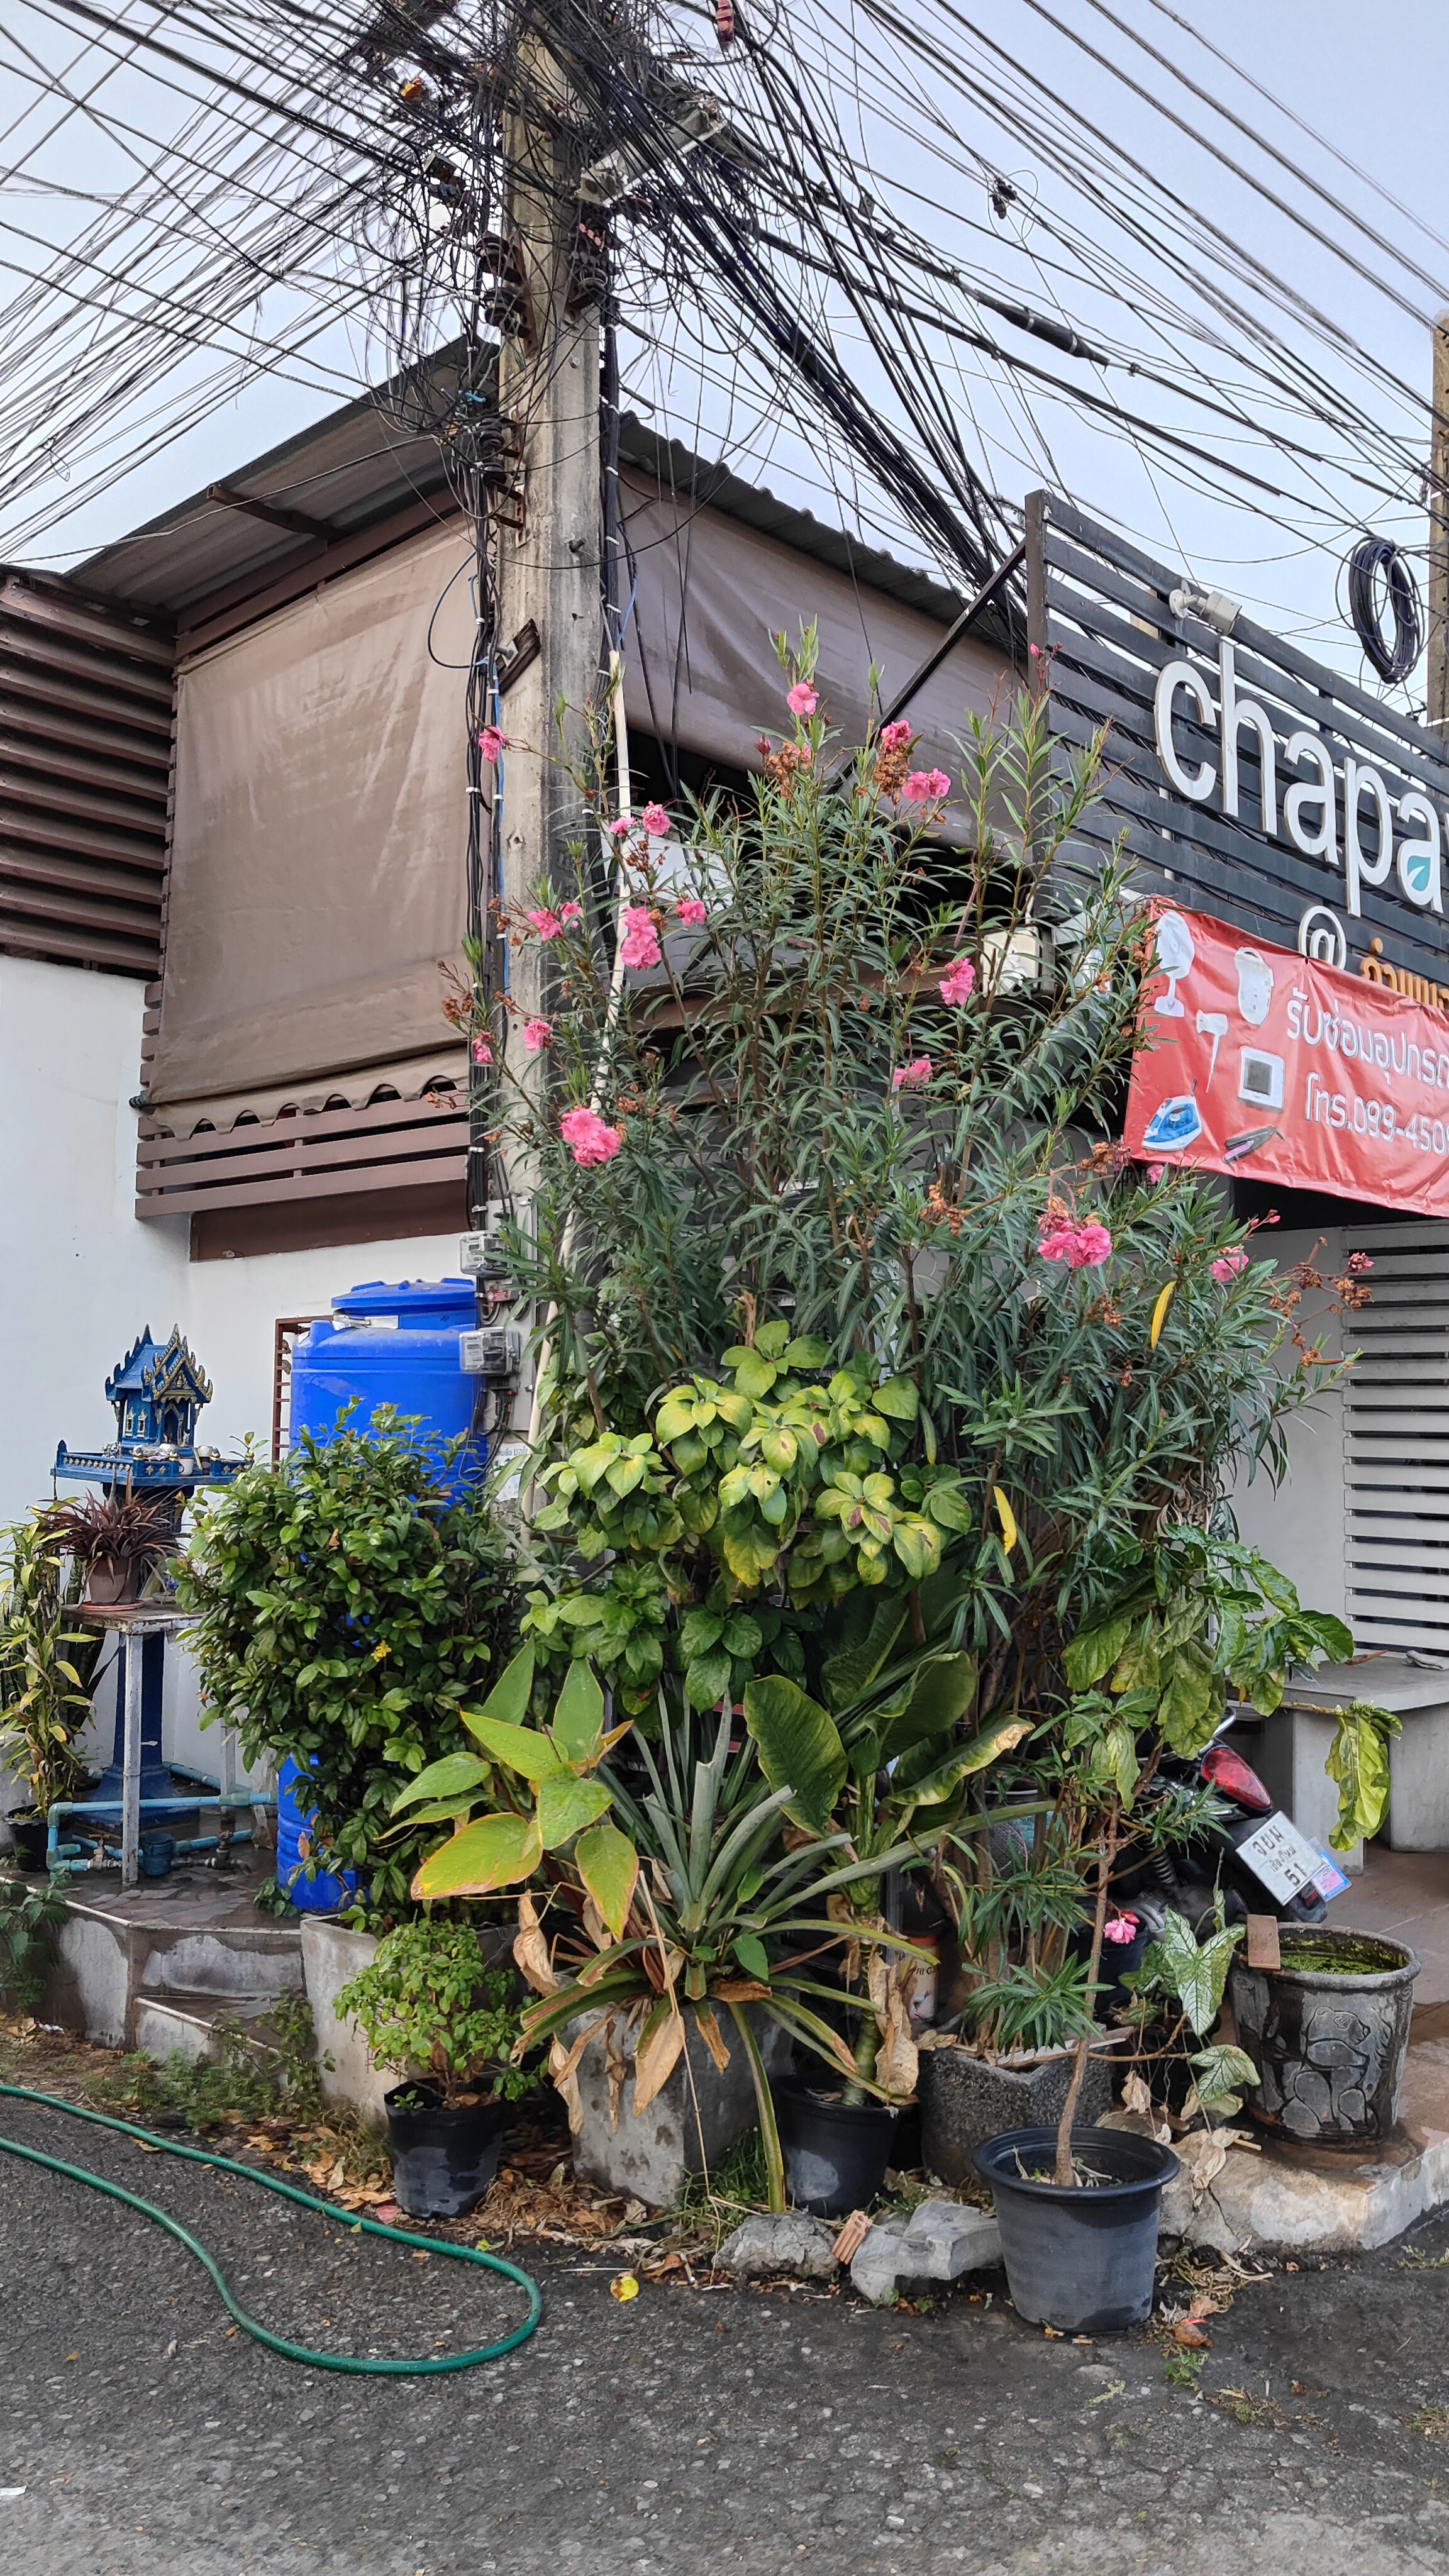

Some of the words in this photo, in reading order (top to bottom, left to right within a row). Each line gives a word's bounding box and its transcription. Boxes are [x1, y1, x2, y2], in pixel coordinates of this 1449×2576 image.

[1155, 641, 1449, 919] chapa
[1304, 1070, 1449, 1156] โทร.099-450
[1283, 1862, 1307, 1887] 51
